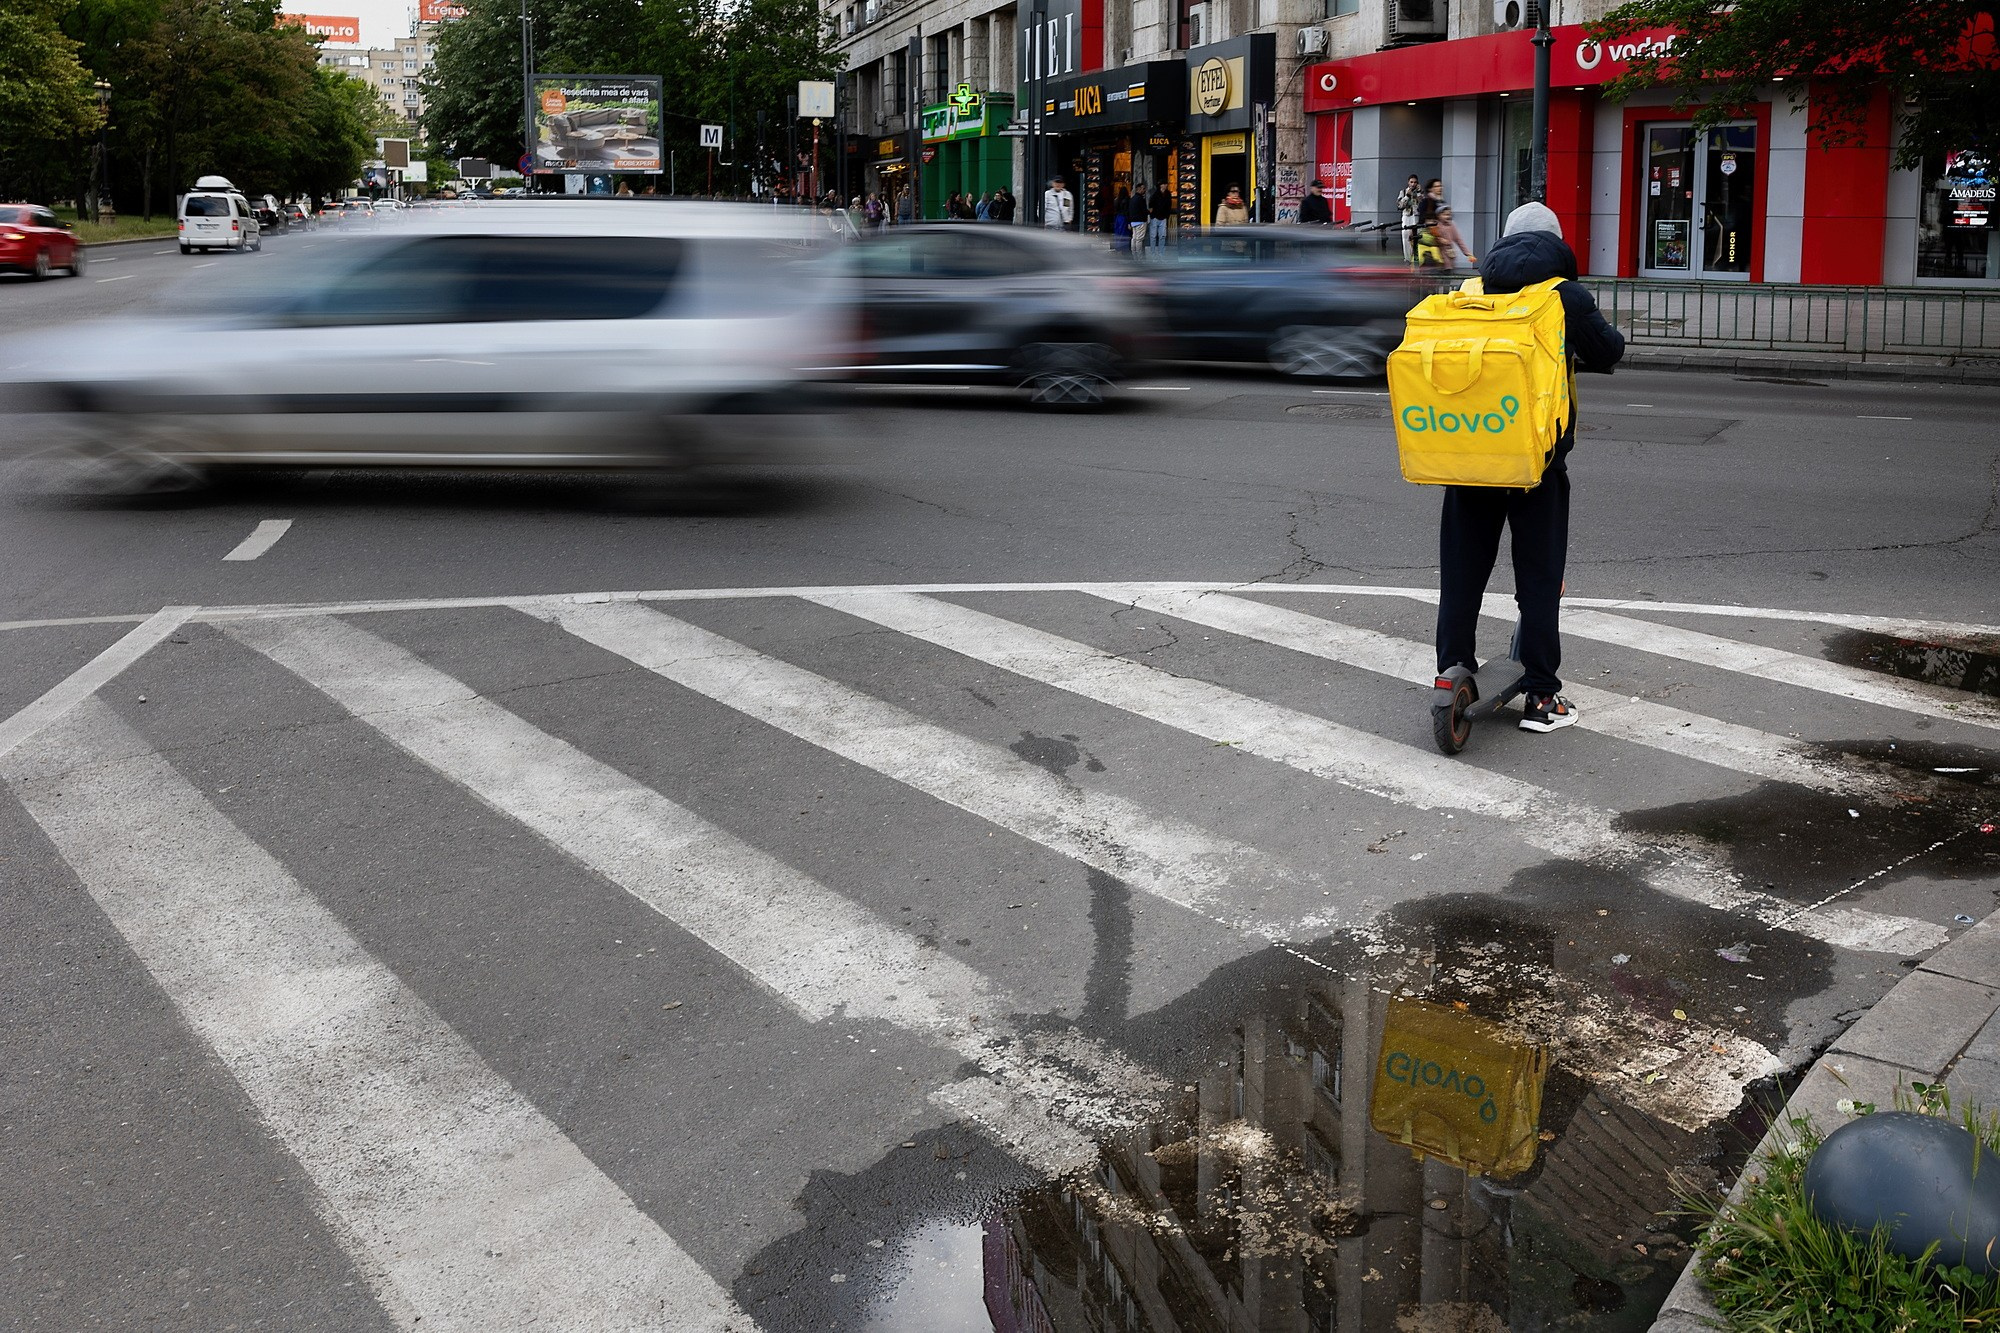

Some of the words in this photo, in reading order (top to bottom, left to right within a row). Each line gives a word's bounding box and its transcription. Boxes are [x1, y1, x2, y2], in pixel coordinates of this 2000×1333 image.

[1201, 66, 1226, 93] EYFEL
[601, 89, 619, 97] mea
[620, 88, 631, 97] de
[1074, 85, 1102, 116] LUCA
[704, 128, 719, 144] M
[1149, 137, 1170, 145] LUCA
[1949, 187, 1996, 197] AMADEUS
[1728, 231, 1736, 262] HONOR
[1402, 405, 1505, 434] Glovo
